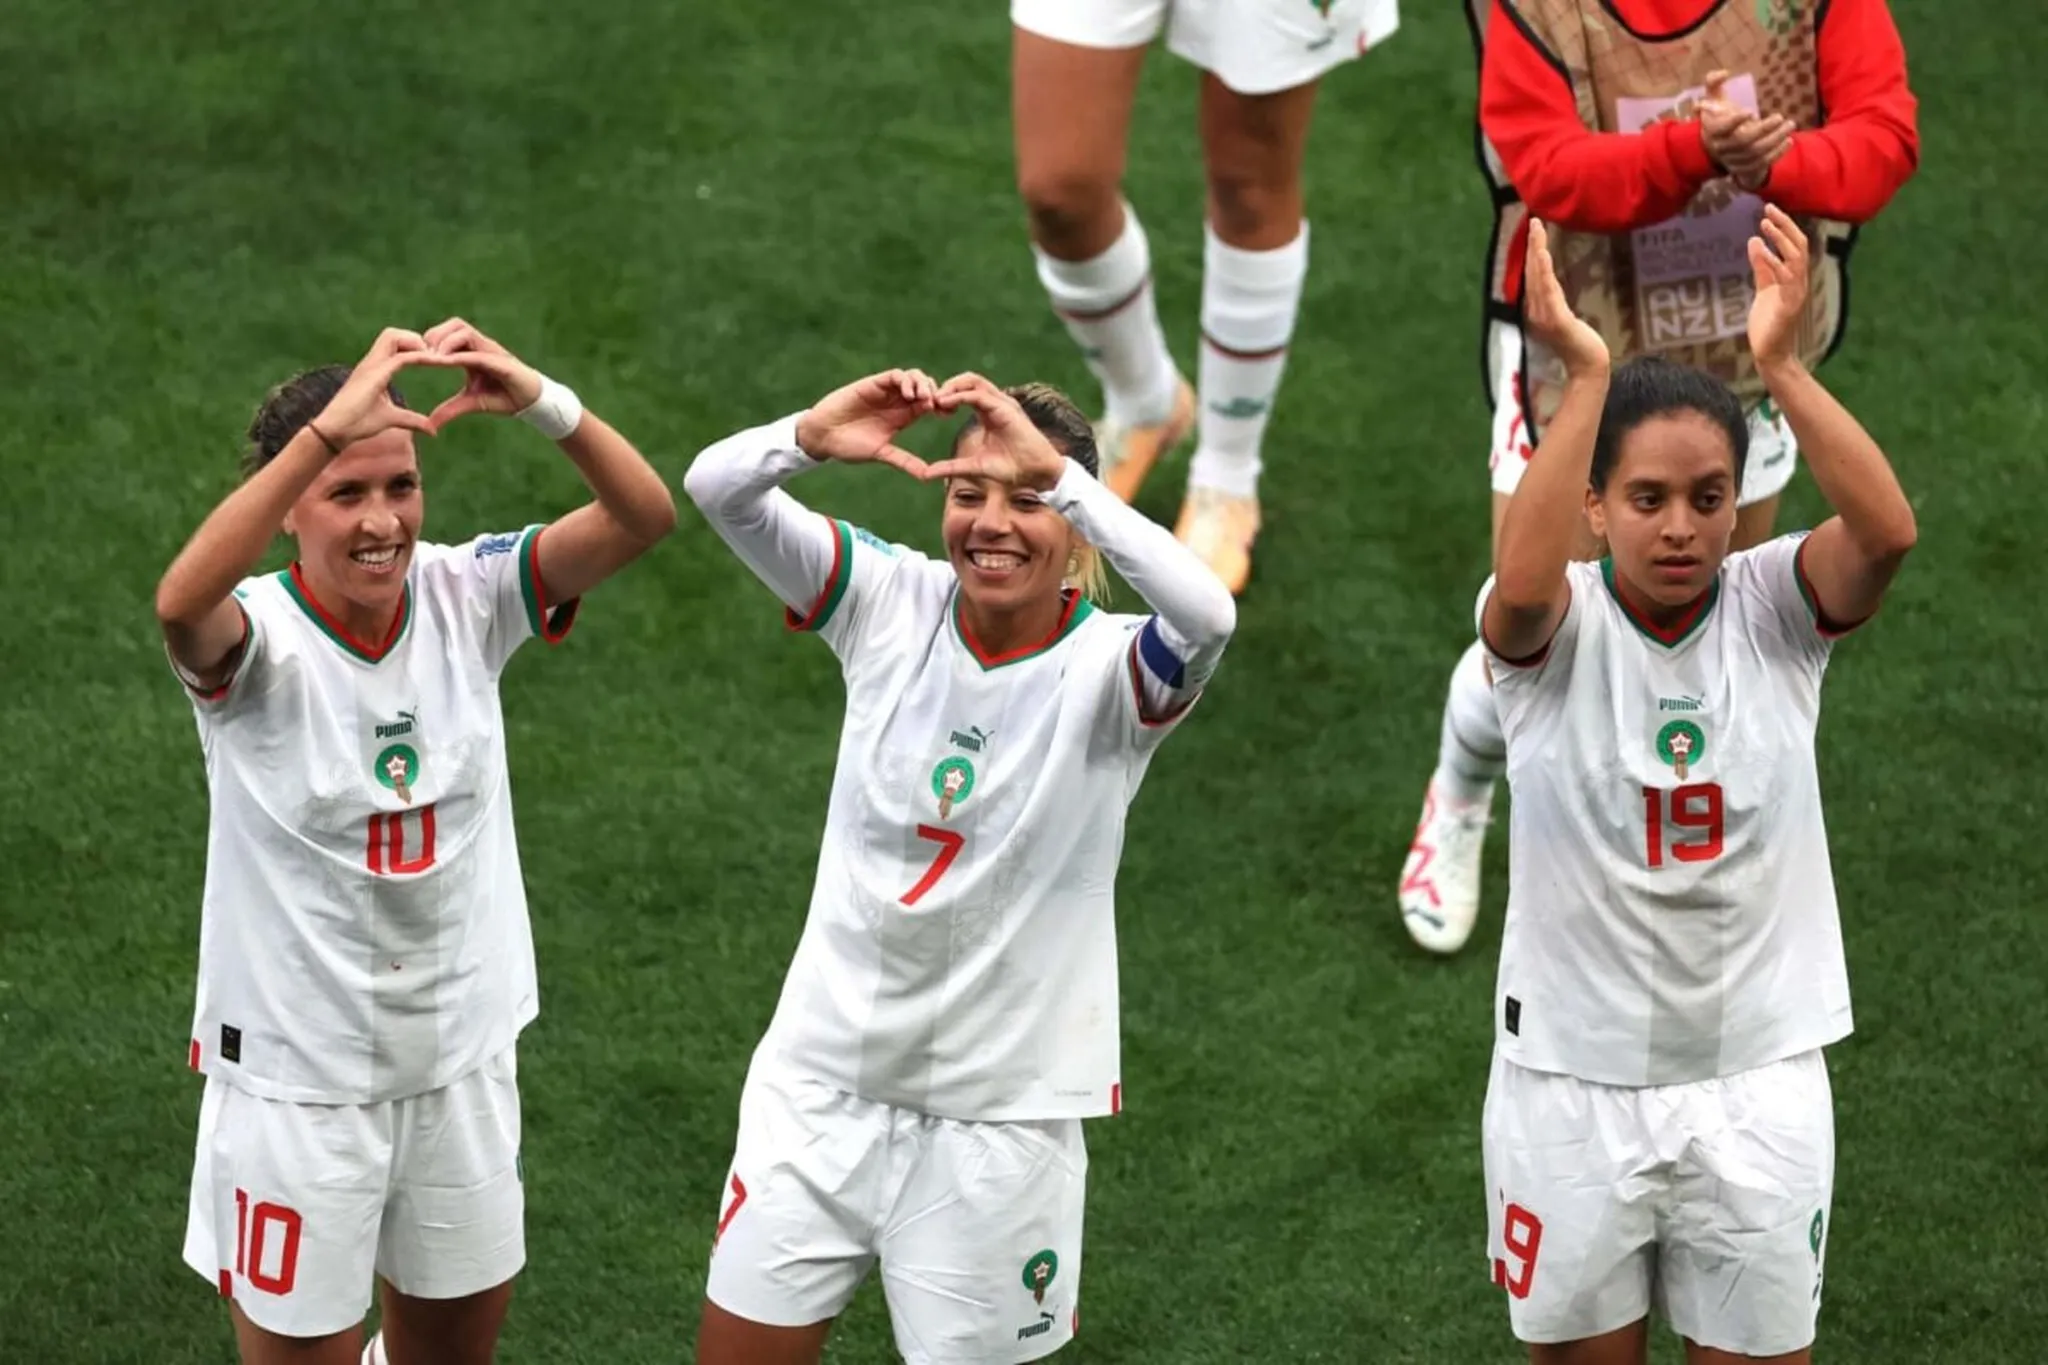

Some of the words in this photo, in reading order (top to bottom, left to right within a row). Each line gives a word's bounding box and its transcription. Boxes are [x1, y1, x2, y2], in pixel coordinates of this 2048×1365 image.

[1648, 280, 1706, 313] AU
[1651, 307, 1713, 341] NZ
[1659, 697, 1699, 711] PUMA
[375, 720, 413, 739] PUMA
[949, 730, 982, 752] PUMA
[366, 802, 436, 876] 10
[1642, 782, 1724, 868] 19
[898, 822, 966, 906] 7
[235, 1187, 302, 1296] 10
[1500, 1190, 1544, 1300] 9
[1017, 1319, 1051, 1341] PUMA
